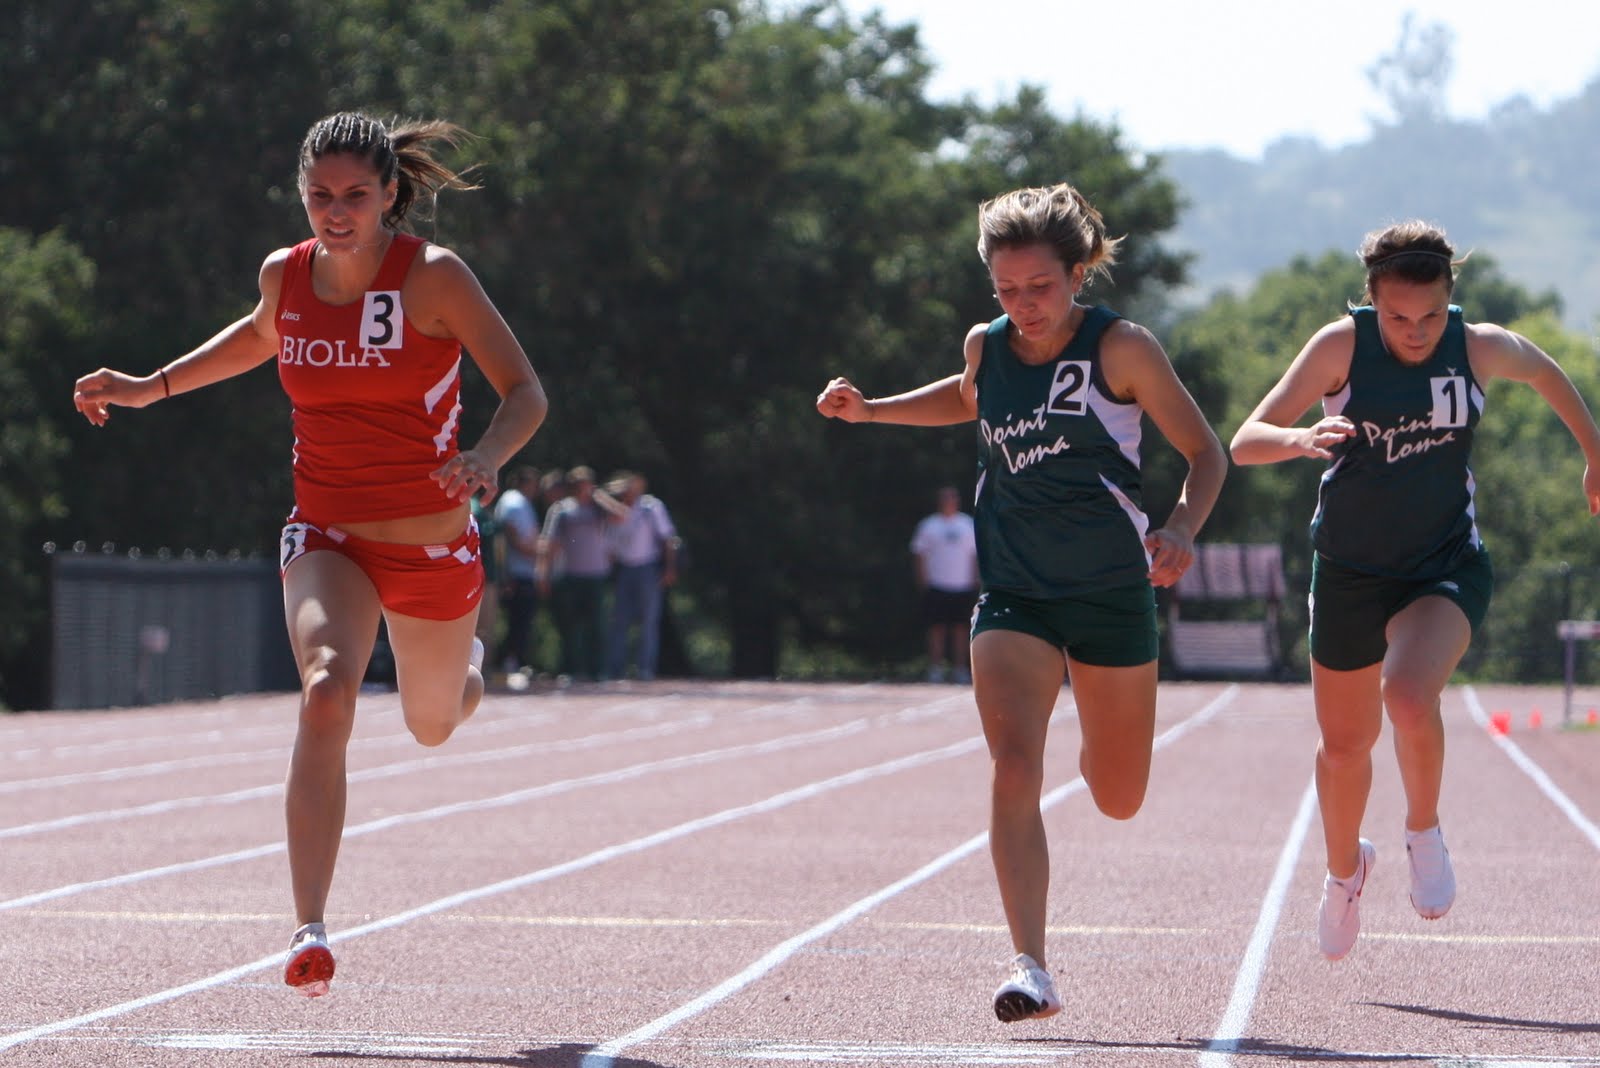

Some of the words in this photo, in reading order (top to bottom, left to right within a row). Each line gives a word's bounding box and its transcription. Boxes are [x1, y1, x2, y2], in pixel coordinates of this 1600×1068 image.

[368, 293, 394, 345] 3
[281, 335, 391, 367] BIOLA
[1051, 363, 1084, 412] 2
[1441, 379, 1457, 424] 1
